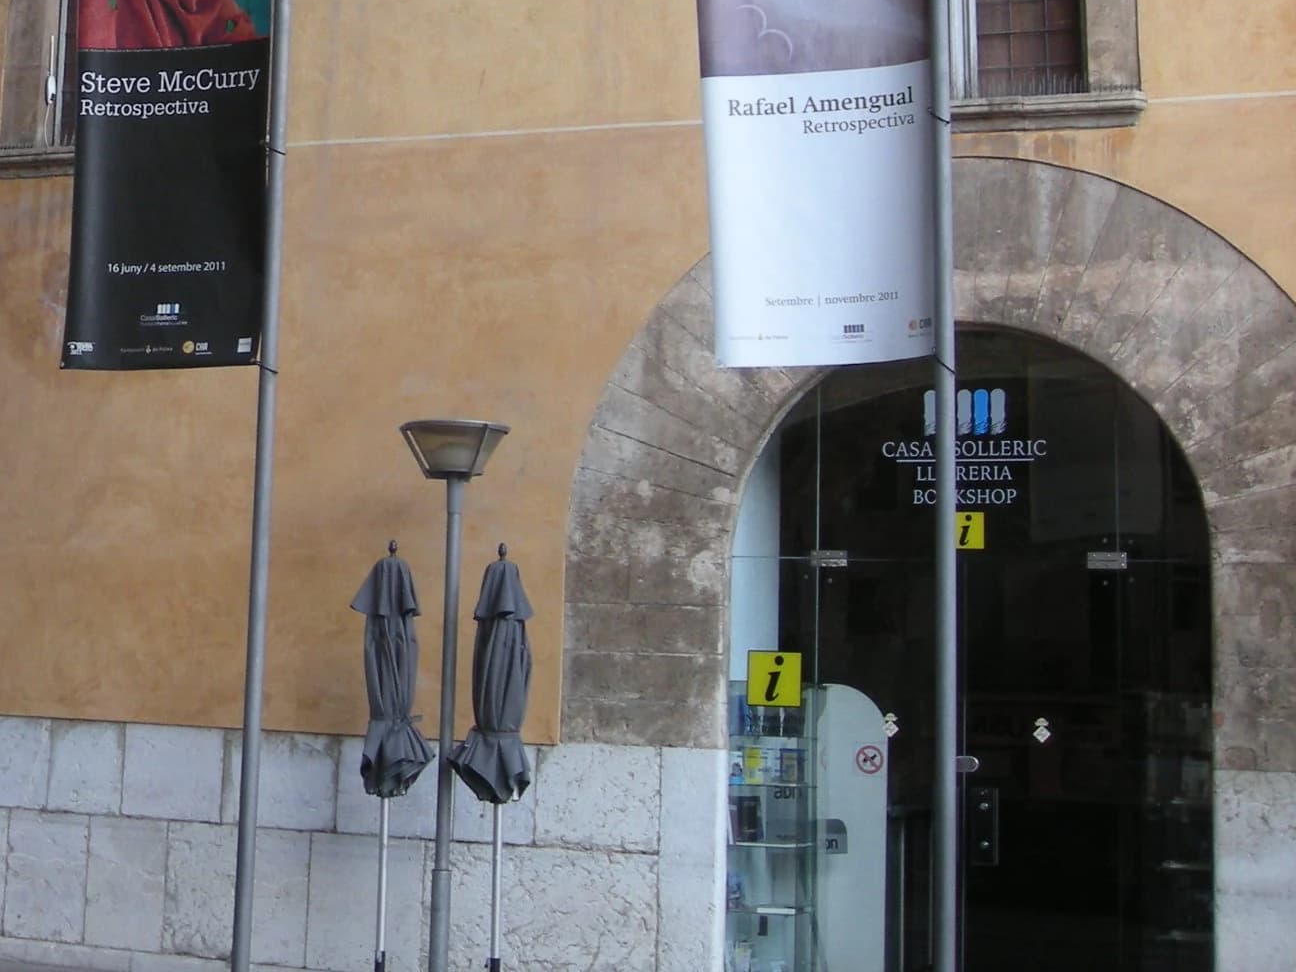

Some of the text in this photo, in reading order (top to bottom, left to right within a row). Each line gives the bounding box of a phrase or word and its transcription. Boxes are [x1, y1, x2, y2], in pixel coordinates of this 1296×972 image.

[80, 68, 261, 94] Steve McCurry
[80, 98, 210, 119] Retrospectiva
[728, 86, 914, 117] Rafael Amengual
[803, 111, 915, 135] Retrospectiva
[107, 263, 120, 273] 16
[120, 263, 142, 275] juny
[149, 263, 156, 273] 4
[158, 262, 202, 273] setembre
[203, 261, 226, 272] 2011
[765, 294, 814, 307] Setembre
[824, 292, 876, 305] novembre
[878, 291, 899, 302] 2011
[882, 439, 1048, 458] CASA SOLLERIC
[916, 465, 1013, 481] LLRERIA
[912, 488, 1017, 505] BOKSHOP
